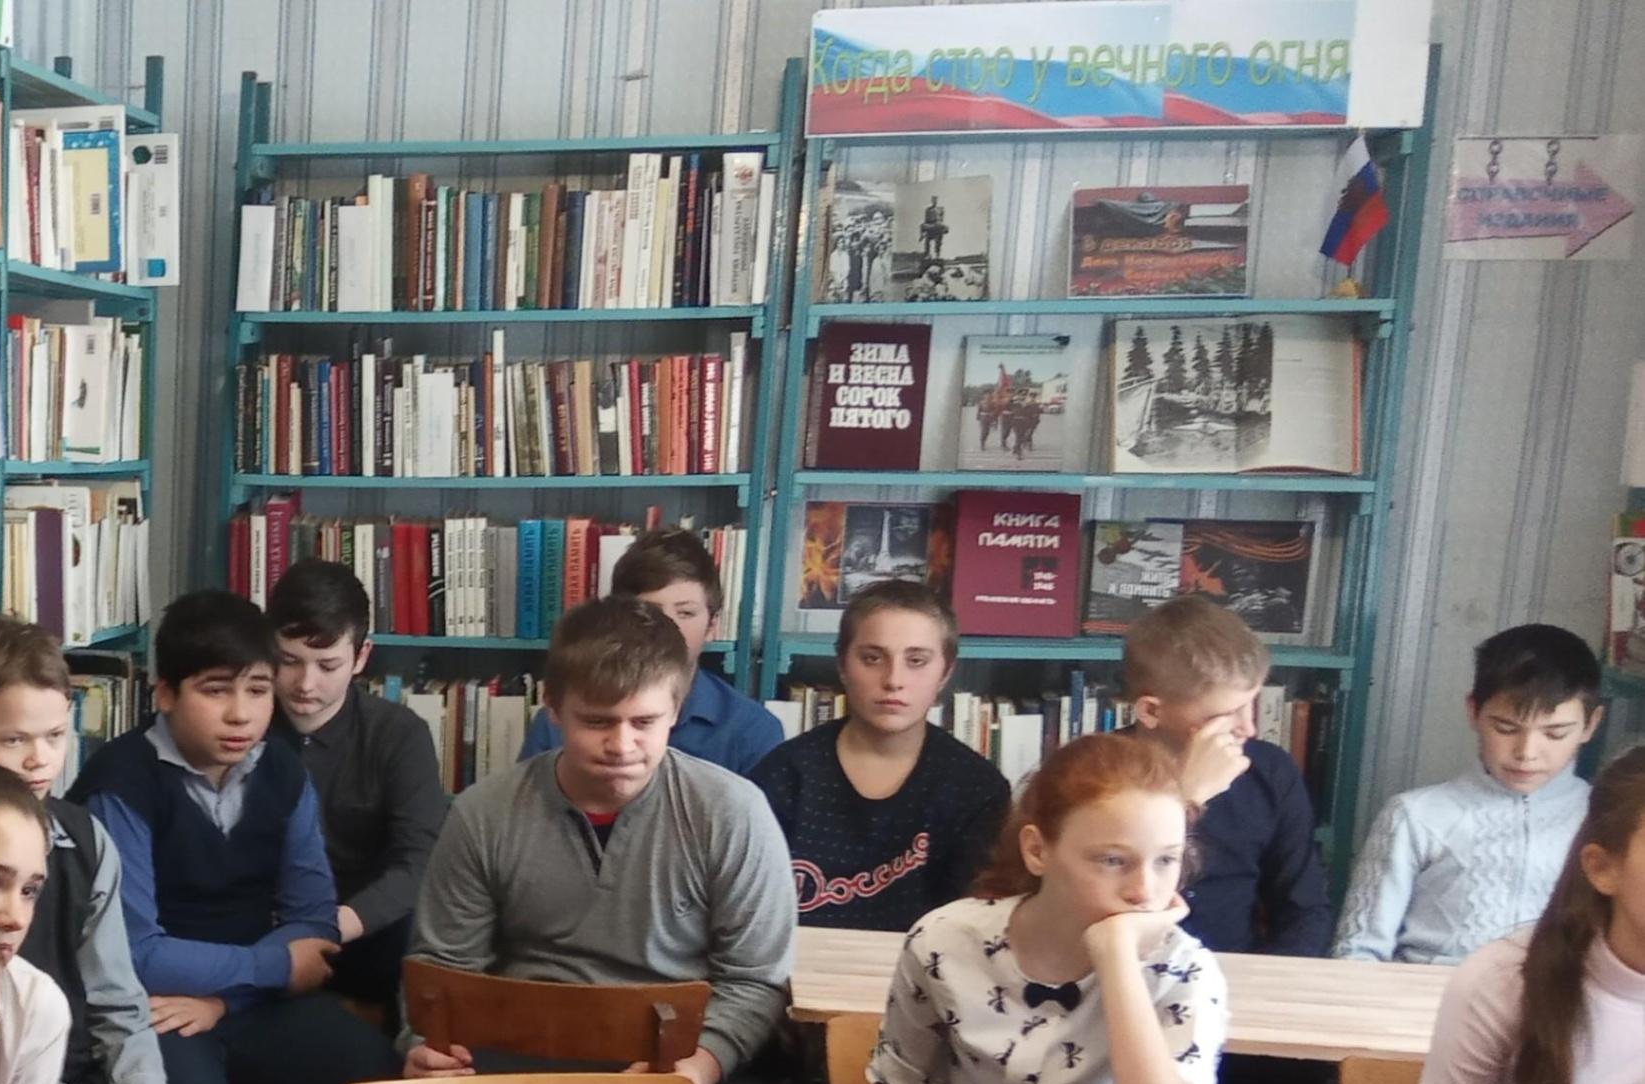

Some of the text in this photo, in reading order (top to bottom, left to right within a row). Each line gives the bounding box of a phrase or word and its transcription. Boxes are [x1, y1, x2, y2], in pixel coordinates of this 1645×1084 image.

[811, 36, 914, 104] Когда
[1027, 46, 1054, 104] у
[1065, 41, 1233, 88] вечного
[1249, 39, 1351, 86] огня
[849, 343, 910, 364] ЗИМА
[827, 364, 915, 386] И ВЕСНА
[835, 385, 902, 407] СОРОК
[829, 407, 912, 430] ПЯТОГО
[993, 511, 1061, 528] КНИГА
[522, 528, 535, 570] ПАМЯТЬ
[545, 528, 559, 570] ПАМЯТЬ
[567, 528, 581, 571] ПАМЯТЬ
[978, 531, 1061, 549] ПАМЯТИ
